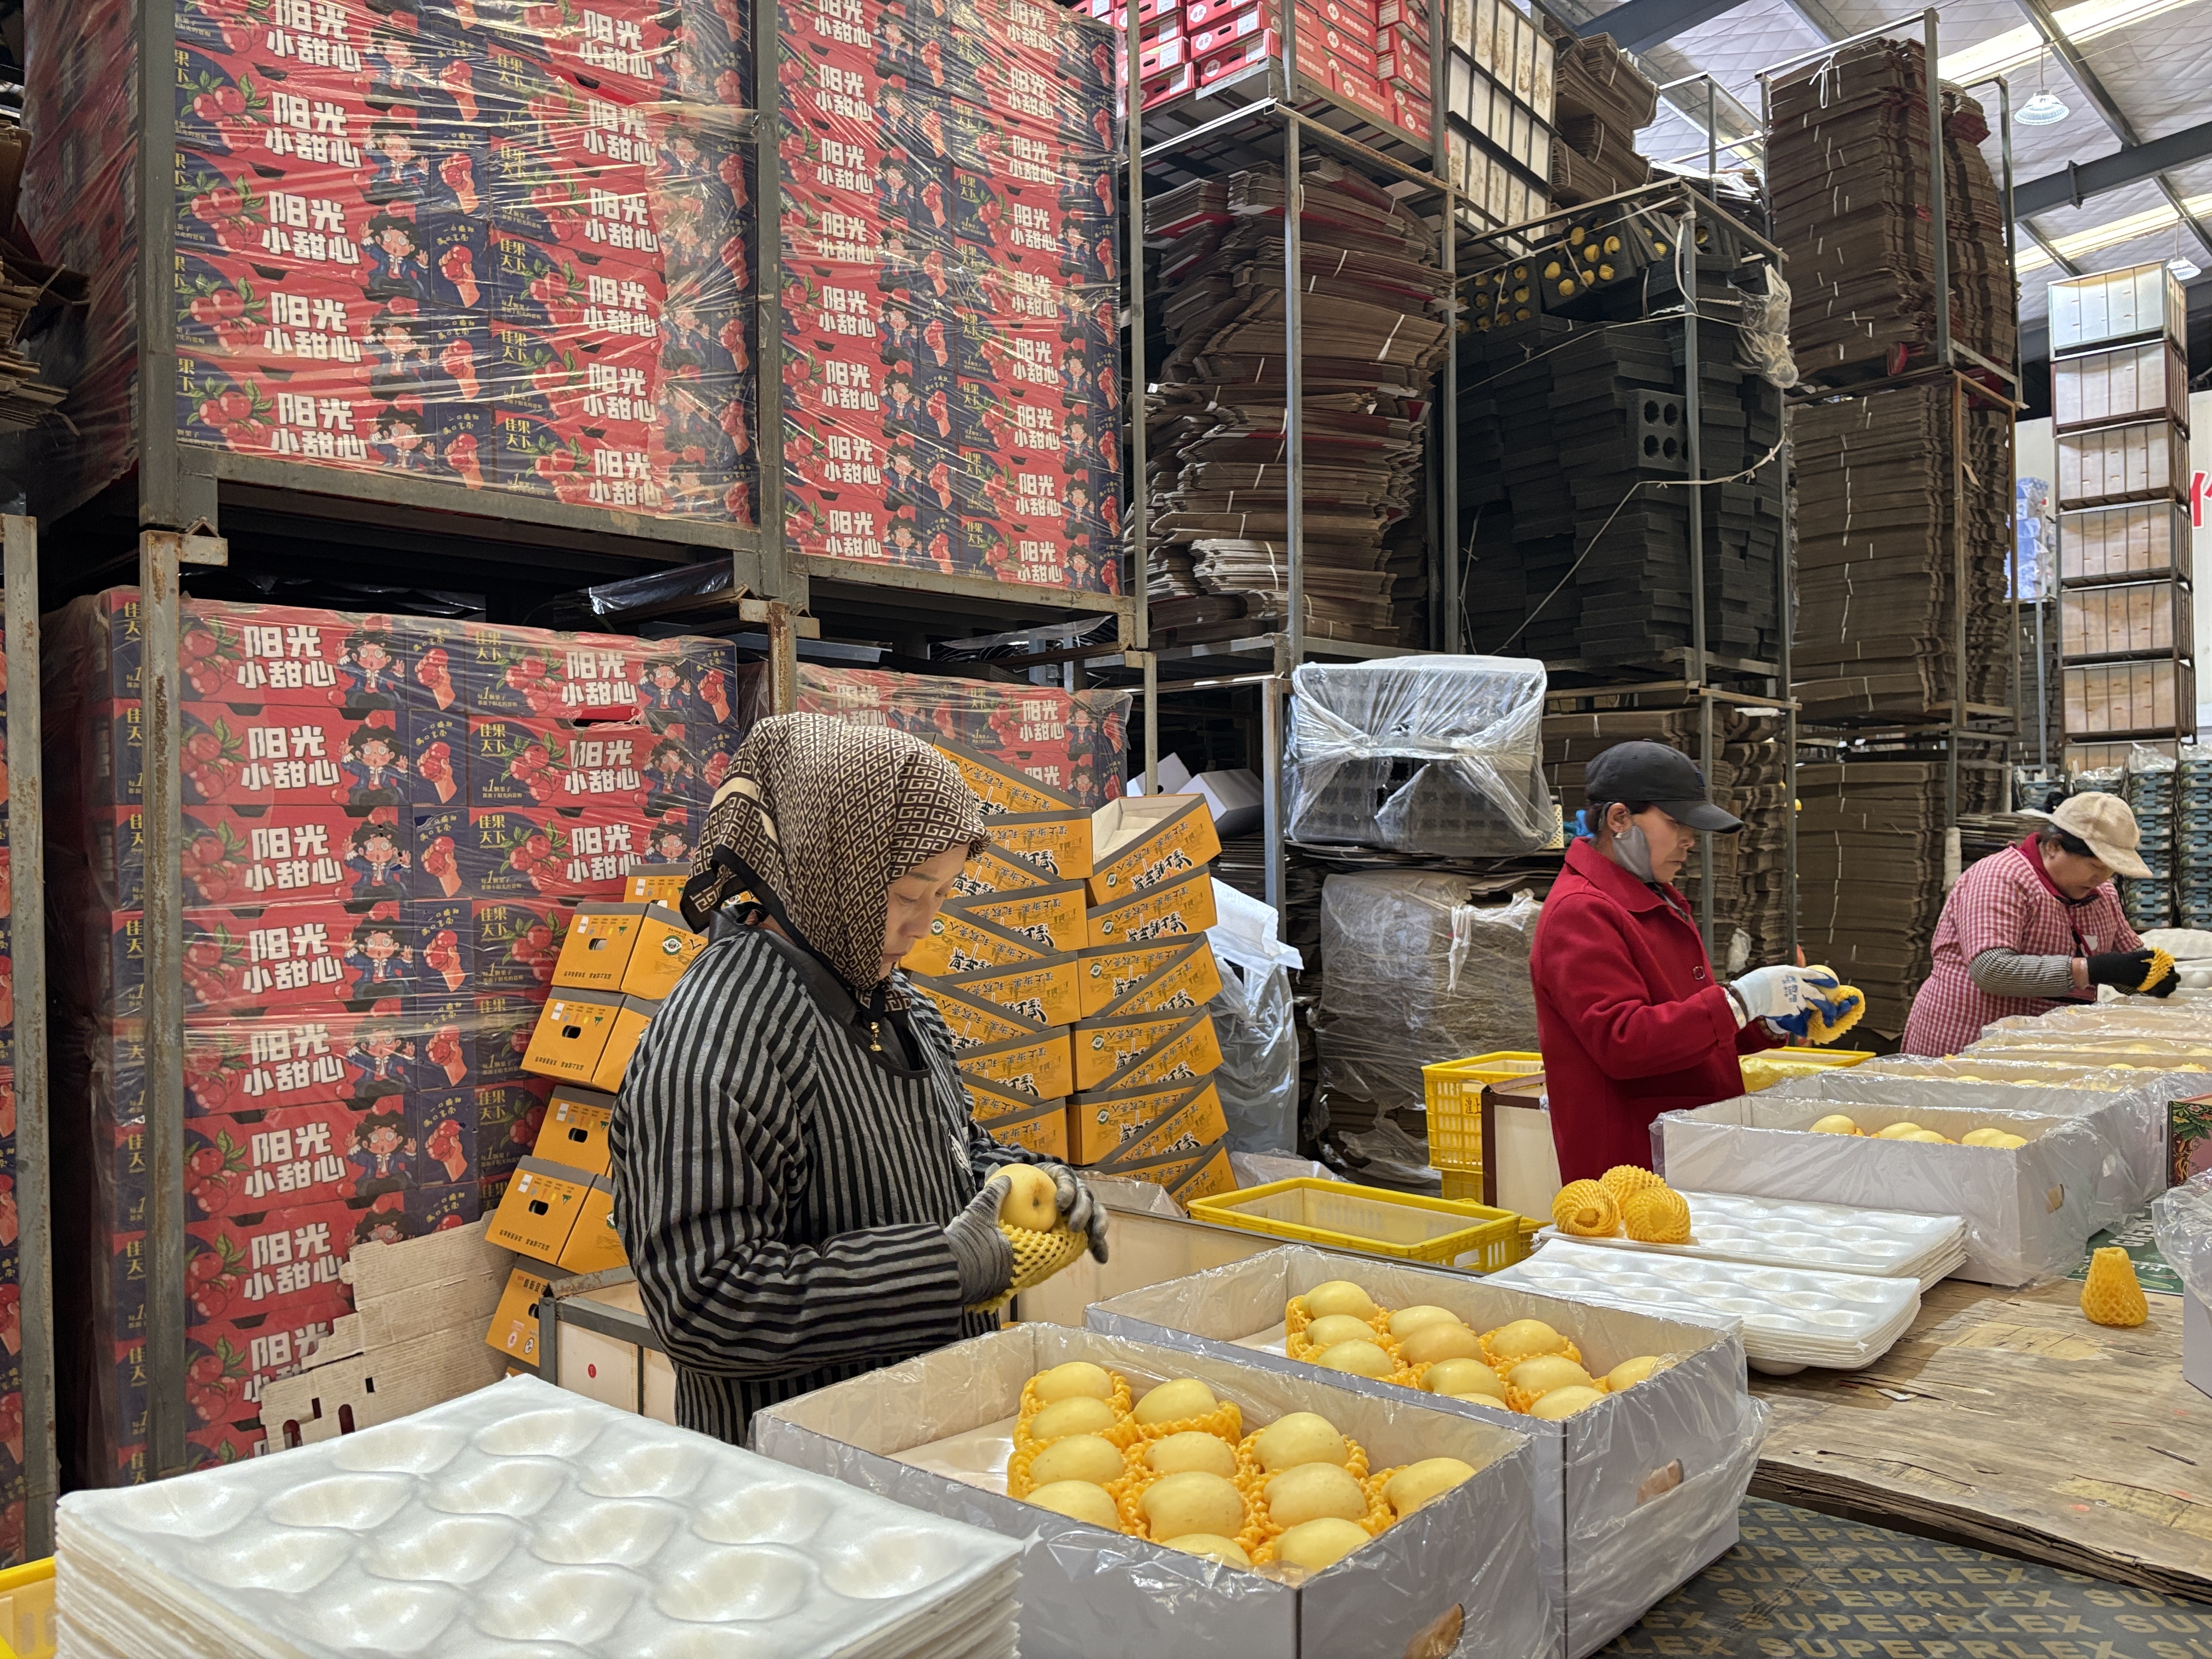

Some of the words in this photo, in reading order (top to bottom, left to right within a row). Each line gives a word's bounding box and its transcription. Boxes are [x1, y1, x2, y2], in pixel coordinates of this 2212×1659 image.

[274, 0, 349, 40] 阳光
[819, 0, 864, 24] 阳光
[583, 9, 643, 52] 阳光
[815, 15, 872, 48] 小甜心
[266, 29, 362, 72] 小甜心
[579, 41, 653, 80] 小甜心
[819, 64, 864, 98] 阳光
[1010, 66, 1047, 98] 阳光
[271, 91, 347, 137] 阳光
[587, 98, 648, 138] 阳光
[816, 91, 873, 122] 小甜心
[1007, 91, 1054, 121] 小甜心
[264, 127, 362, 167] 小甜心
[583, 130, 657, 166] 小甜心
[821, 138, 865, 172] 阳光
[1012, 135, 1048, 165] 阳光
[816, 166, 873, 194] 小甜心
[1008, 159, 1056, 186] 小甜心
[268, 191, 345, 233] 阳光
[589, 187, 648, 226] 阳光
[1013, 202, 1049, 232] 阳光
[584, 218, 659, 253] 小甜心
[822, 212, 867, 242] 阳光
[1011, 227, 1057, 252] 小甜心
[261, 227, 360, 264] 小甜心
[500, 237, 526, 257] 佳果
[817, 238, 874, 265] 小甜心
[500, 252, 526, 272] 天下
[588, 275, 647, 311] 阳光
[822, 286, 868, 314] 阳光
[270, 291, 348, 333] 阳光
[583, 307, 657, 337] 小甜心
[819, 313, 877, 338] 小甜心
[263, 328, 362, 363] 小甜心
[501, 330, 527, 347] 佳果
[501, 345, 527, 361] 天下
[1015, 338, 1052, 365] 阳光
[588, 363, 647, 396] 阳光
[825, 360, 871, 389] 阳光
[1012, 360, 1059, 384] 小甜心
[277, 392, 353, 431] 阳光
[583, 394, 657, 423] 小甜心
[822, 386, 879, 411] 小甜心
[505, 417, 531, 434] 佳果
[1017, 405, 1053, 430] 阳光
[270, 428, 368, 461] 小甜心
[505, 432, 531, 448] 天下
[827, 435, 873, 463] 阳光
[1014, 428, 1060, 451] 小甜心
[594, 448, 651, 480] 阳光
[823, 460, 882, 486] 小甜心
[589, 479, 663, 506] 小甜心
[1018, 473, 1054, 498] 阳光
[1015, 496, 1062, 518] 小甜心
[828, 510, 874, 536] 阳光
[826, 536, 883, 558] 小甜心
[1019, 540, 1056, 563] 阳光
[1017, 563, 1063, 583] 小甜心
[244, 626, 322, 658] 阳光
[237, 660, 337, 689] 小甜心
[566, 652, 626, 679] 阳光
[562, 680, 639, 706] 小甜心
[1022, 699, 1057, 722] 阳光
[247, 725, 326, 760] 阳光
[481, 724, 505, 737] 佳果
[1019, 722, 1065, 742] 小甜心
[481, 740, 505, 753] 天下
[569, 740, 633, 769] 阳光
[241, 760, 340, 791] 小甜心
[565, 768, 640, 794] 小甜心
[1024, 765, 1060, 787] 阳光
[479, 816, 505, 829] 佳果
[479, 831, 505, 843] 天下
[251, 825, 329, 860] 阳光
[572, 824, 632, 855] 阳光
[244, 858, 343, 891] 小甜心
[567, 853, 641, 883] 小甜心
[481, 907, 507, 921] 佳果
[249, 923, 329, 961] 阳光
[482, 923, 507, 936] 天下
[243, 956, 344, 994] 小甜心
[251, 1024, 330, 1065] 阳光
[243, 1056, 345, 1096] 小甜心
[252, 1123, 332, 1166] 阳光
[245, 1155, 346, 1198] 小甜心
[251, 1222, 332, 1269] 阳光
[244, 1255, 342, 1301] 小甜心
[251, 1322, 329, 1373] 阳光
